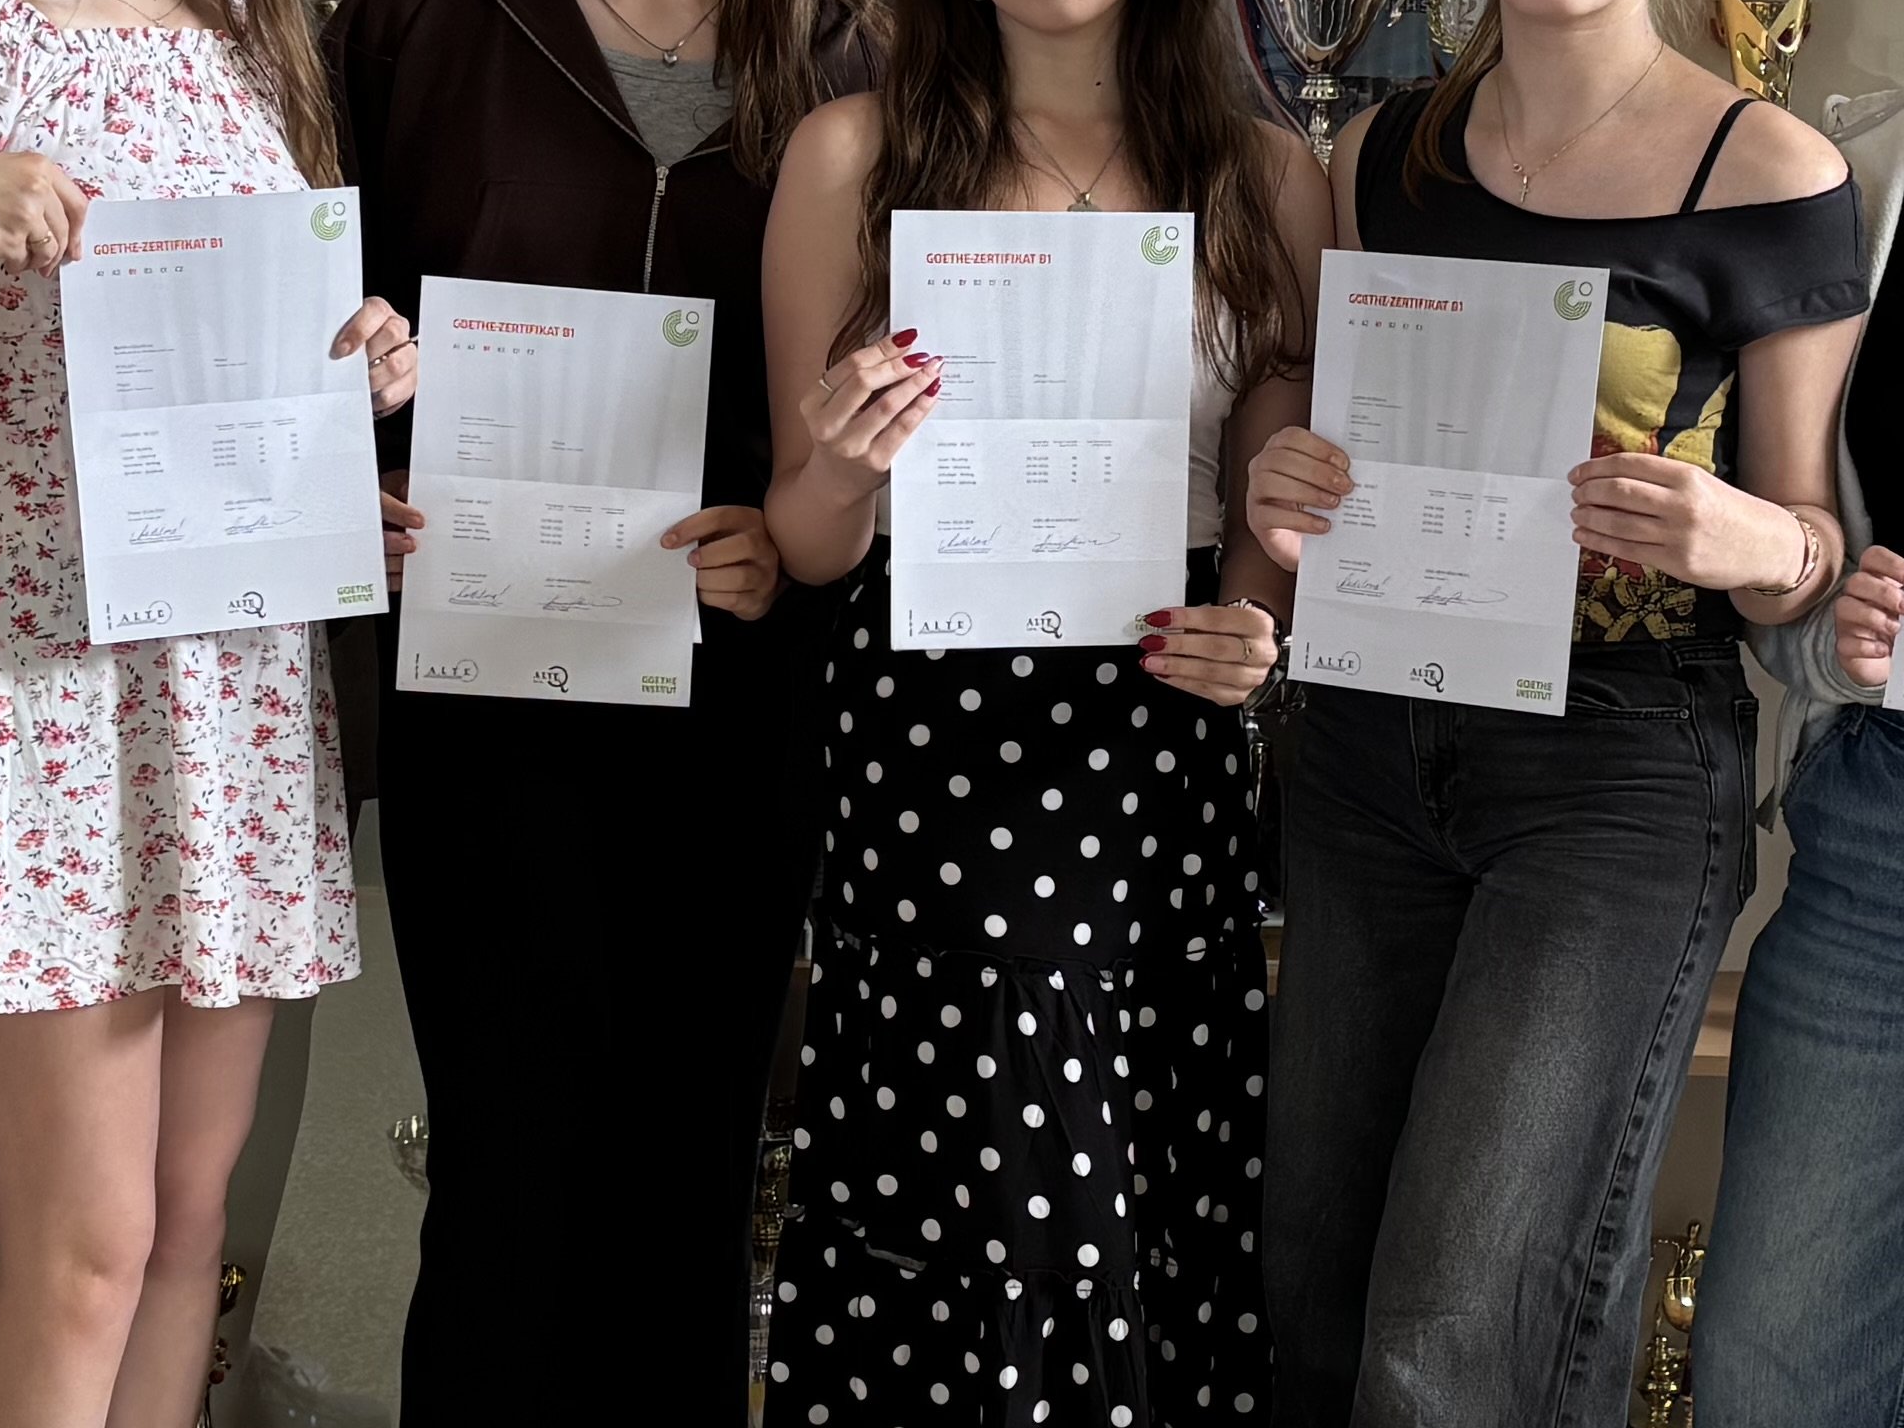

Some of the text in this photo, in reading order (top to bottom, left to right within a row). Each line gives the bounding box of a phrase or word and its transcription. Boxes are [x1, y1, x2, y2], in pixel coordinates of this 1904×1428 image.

[94, 238, 207, 255] GOETHE-ZERTIFIKAT
[926, 253, 1036, 264] GOETHE-ZERTIFIKAT
[453, 318, 560, 337] GOETHE-ZERTIFIKAT
